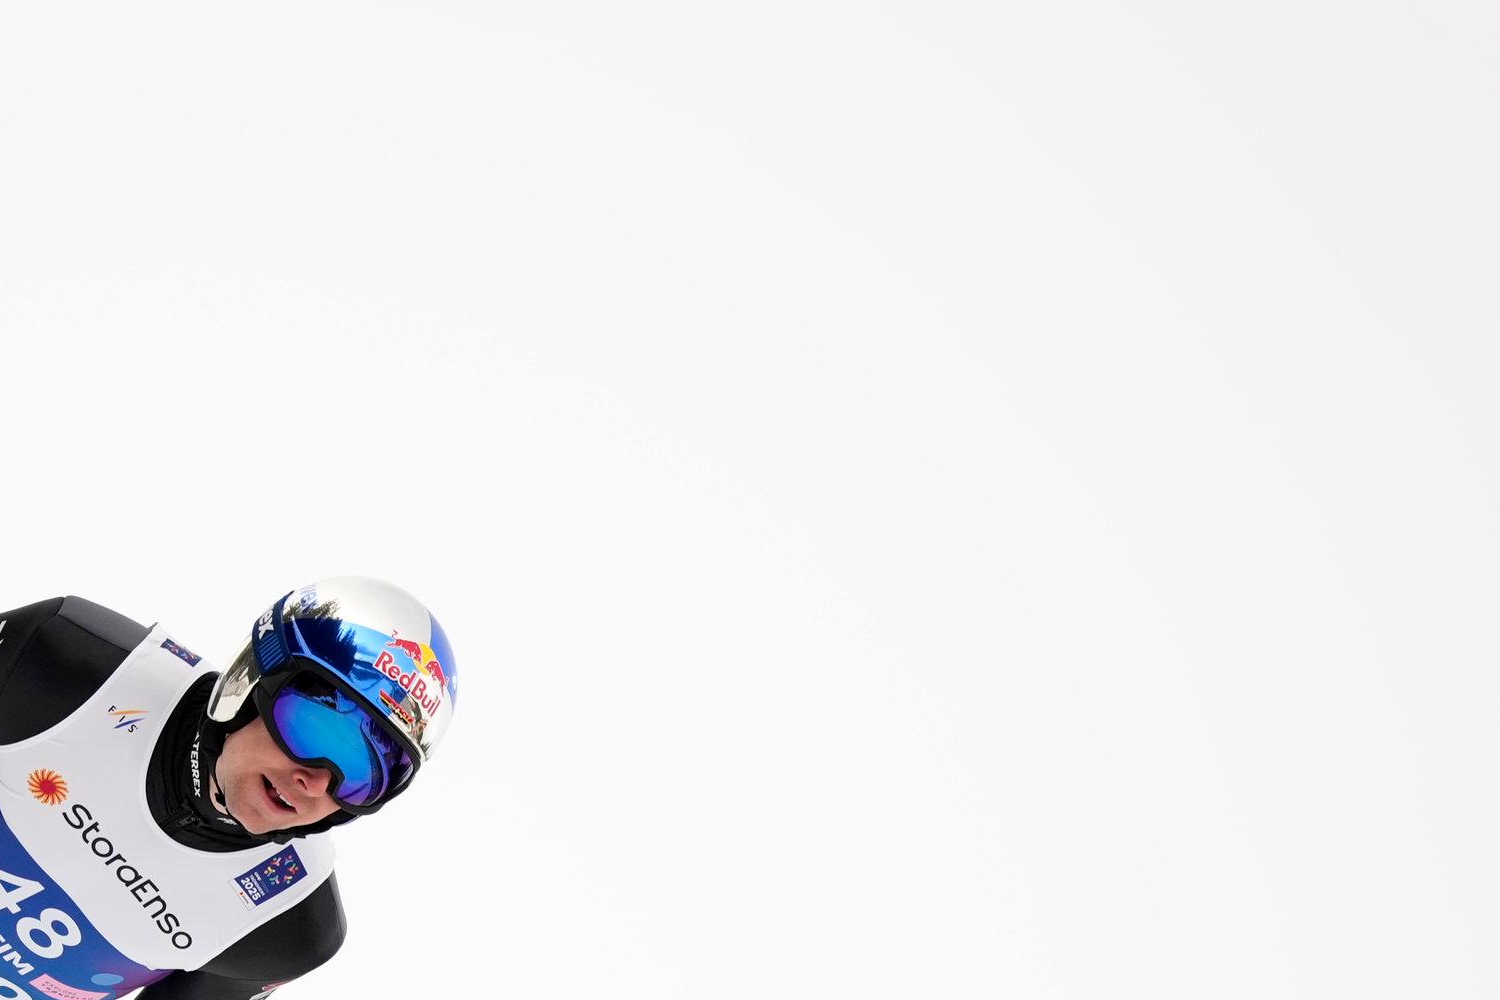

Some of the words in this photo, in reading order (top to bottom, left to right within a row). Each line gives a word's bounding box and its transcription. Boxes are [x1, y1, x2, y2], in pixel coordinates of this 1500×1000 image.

[374, 650, 417, 690] Red
[411, 678, 441, 718] Bull
[190, 741, 201, 798] TERREX
[240, 877, 262, 901] 2025
